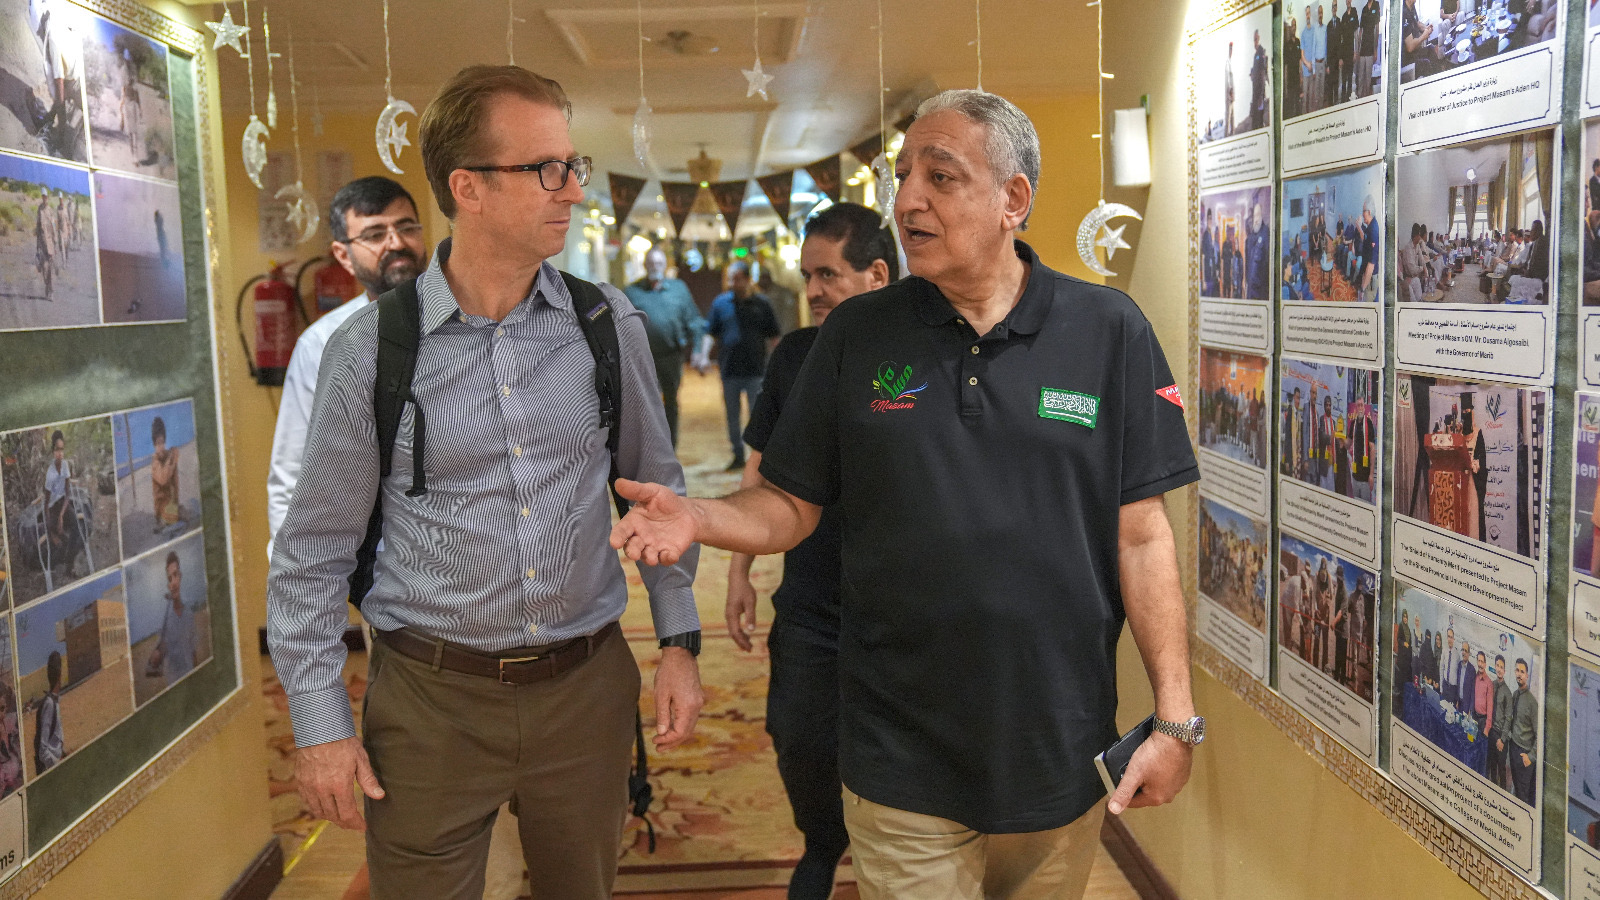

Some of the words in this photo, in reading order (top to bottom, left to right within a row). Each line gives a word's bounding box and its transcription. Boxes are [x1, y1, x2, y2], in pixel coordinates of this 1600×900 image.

[1474, 94, 1491, 104] Project
[1515, 84, 1530, 93] Aden
[1530, 80, 1540, 89] HQ
[870, 400, 914, 412] Masam
[1490, 577, 1508, 590] Project
[1509, 584, 1527, 597] Masam
[1505, 598, 1524, 612] Project
[1586, 612, 1597, 623] The
[1483, 810, 1522, 841] documentary
[1498, 834, 1515, 850] Aden
